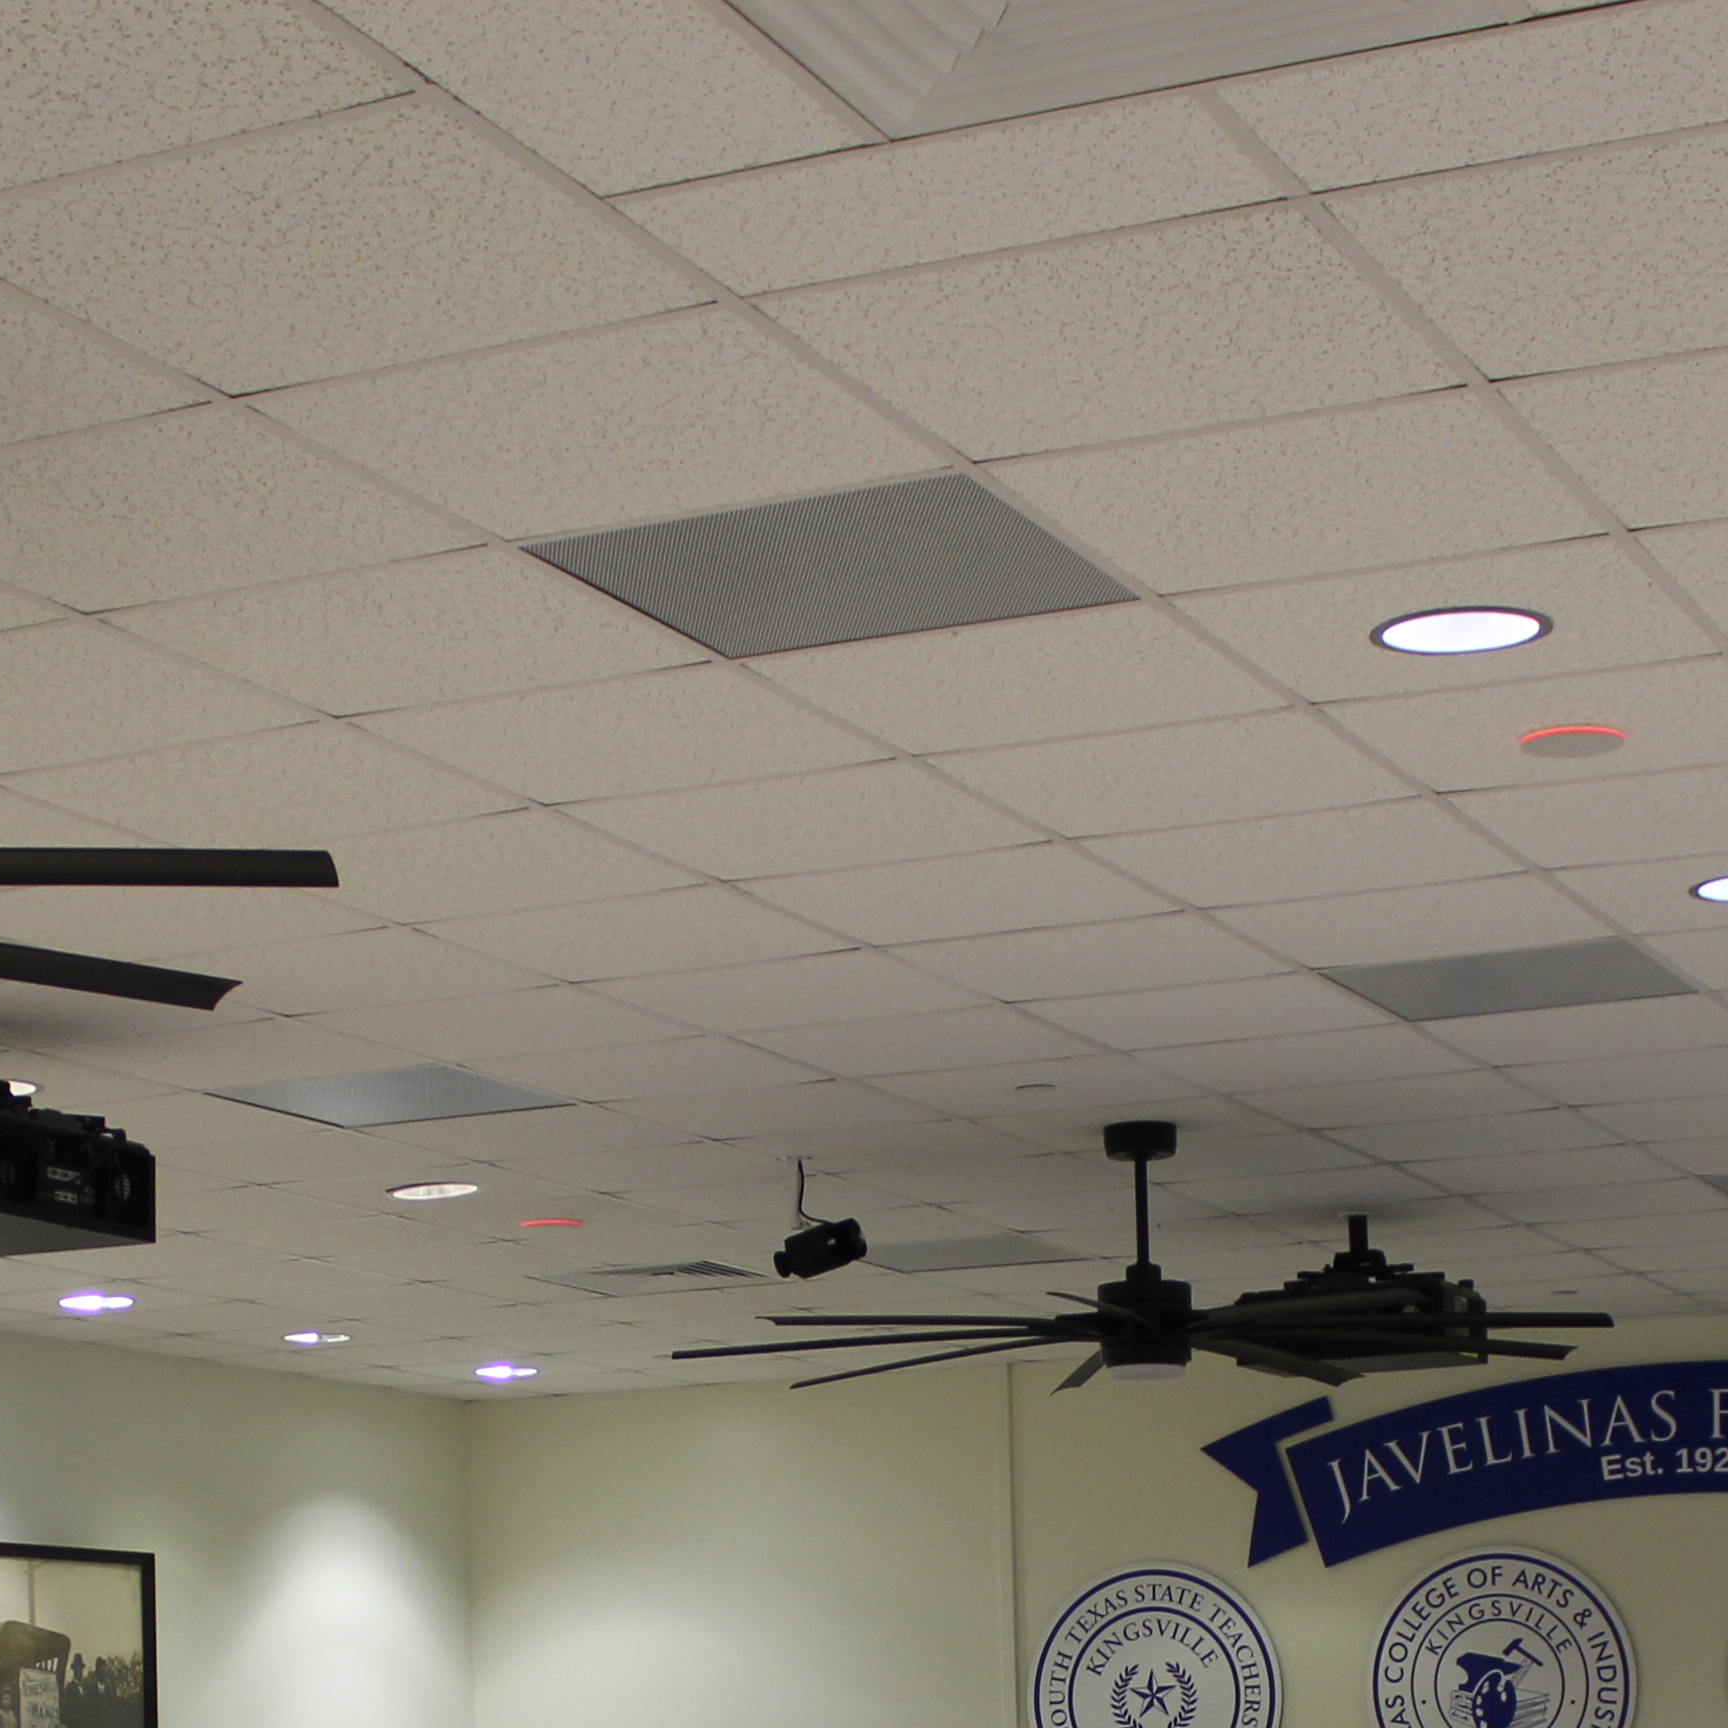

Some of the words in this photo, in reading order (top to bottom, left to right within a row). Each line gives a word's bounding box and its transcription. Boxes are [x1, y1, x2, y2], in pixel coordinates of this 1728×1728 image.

[1327, 1389, 1677, 1524] JAVELINAS
[1600, 1451, 1663, 1481] Est.
[1065, 1589, 1129, 1646] TEXAS
[1134, 1583, 1205, 1612] STATE
[1207, 1603, 1262, 1728] TEACHERS
[1086, 1617, 1219, 1677] KINGSVILLE
[1384, 1577, 1460, 1684] COLLEGE
[1467, 1566, 1503, 1589] OF
[1512, 1568, 1575, 1609] ARTS
[1573, 1607, 1593, 1630] &
[1425, 1600, 1574, 1656] KINGSVILLE
